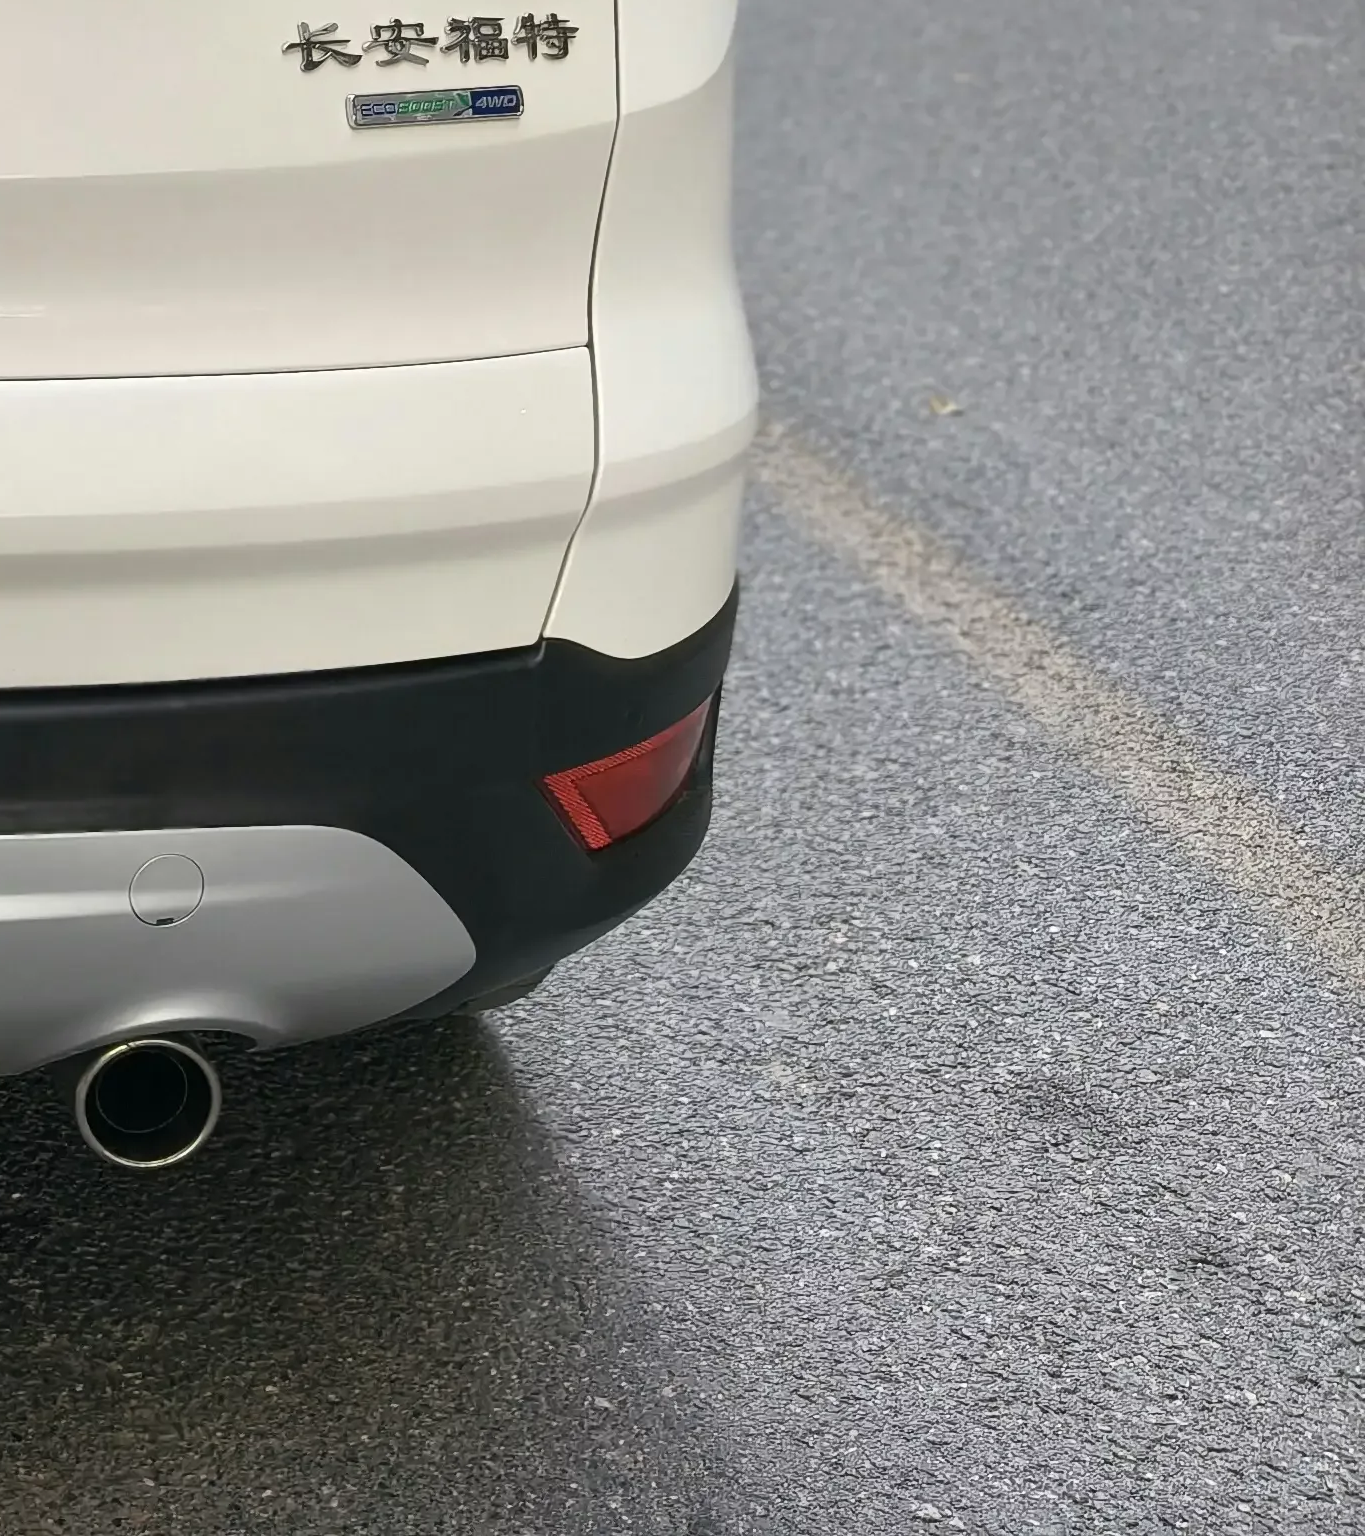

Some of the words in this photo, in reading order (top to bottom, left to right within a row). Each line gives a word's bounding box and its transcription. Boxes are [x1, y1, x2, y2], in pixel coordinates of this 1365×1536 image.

[281, 11, 580, 73] 长安福特
[475, 94, 517, 110] 4WD
